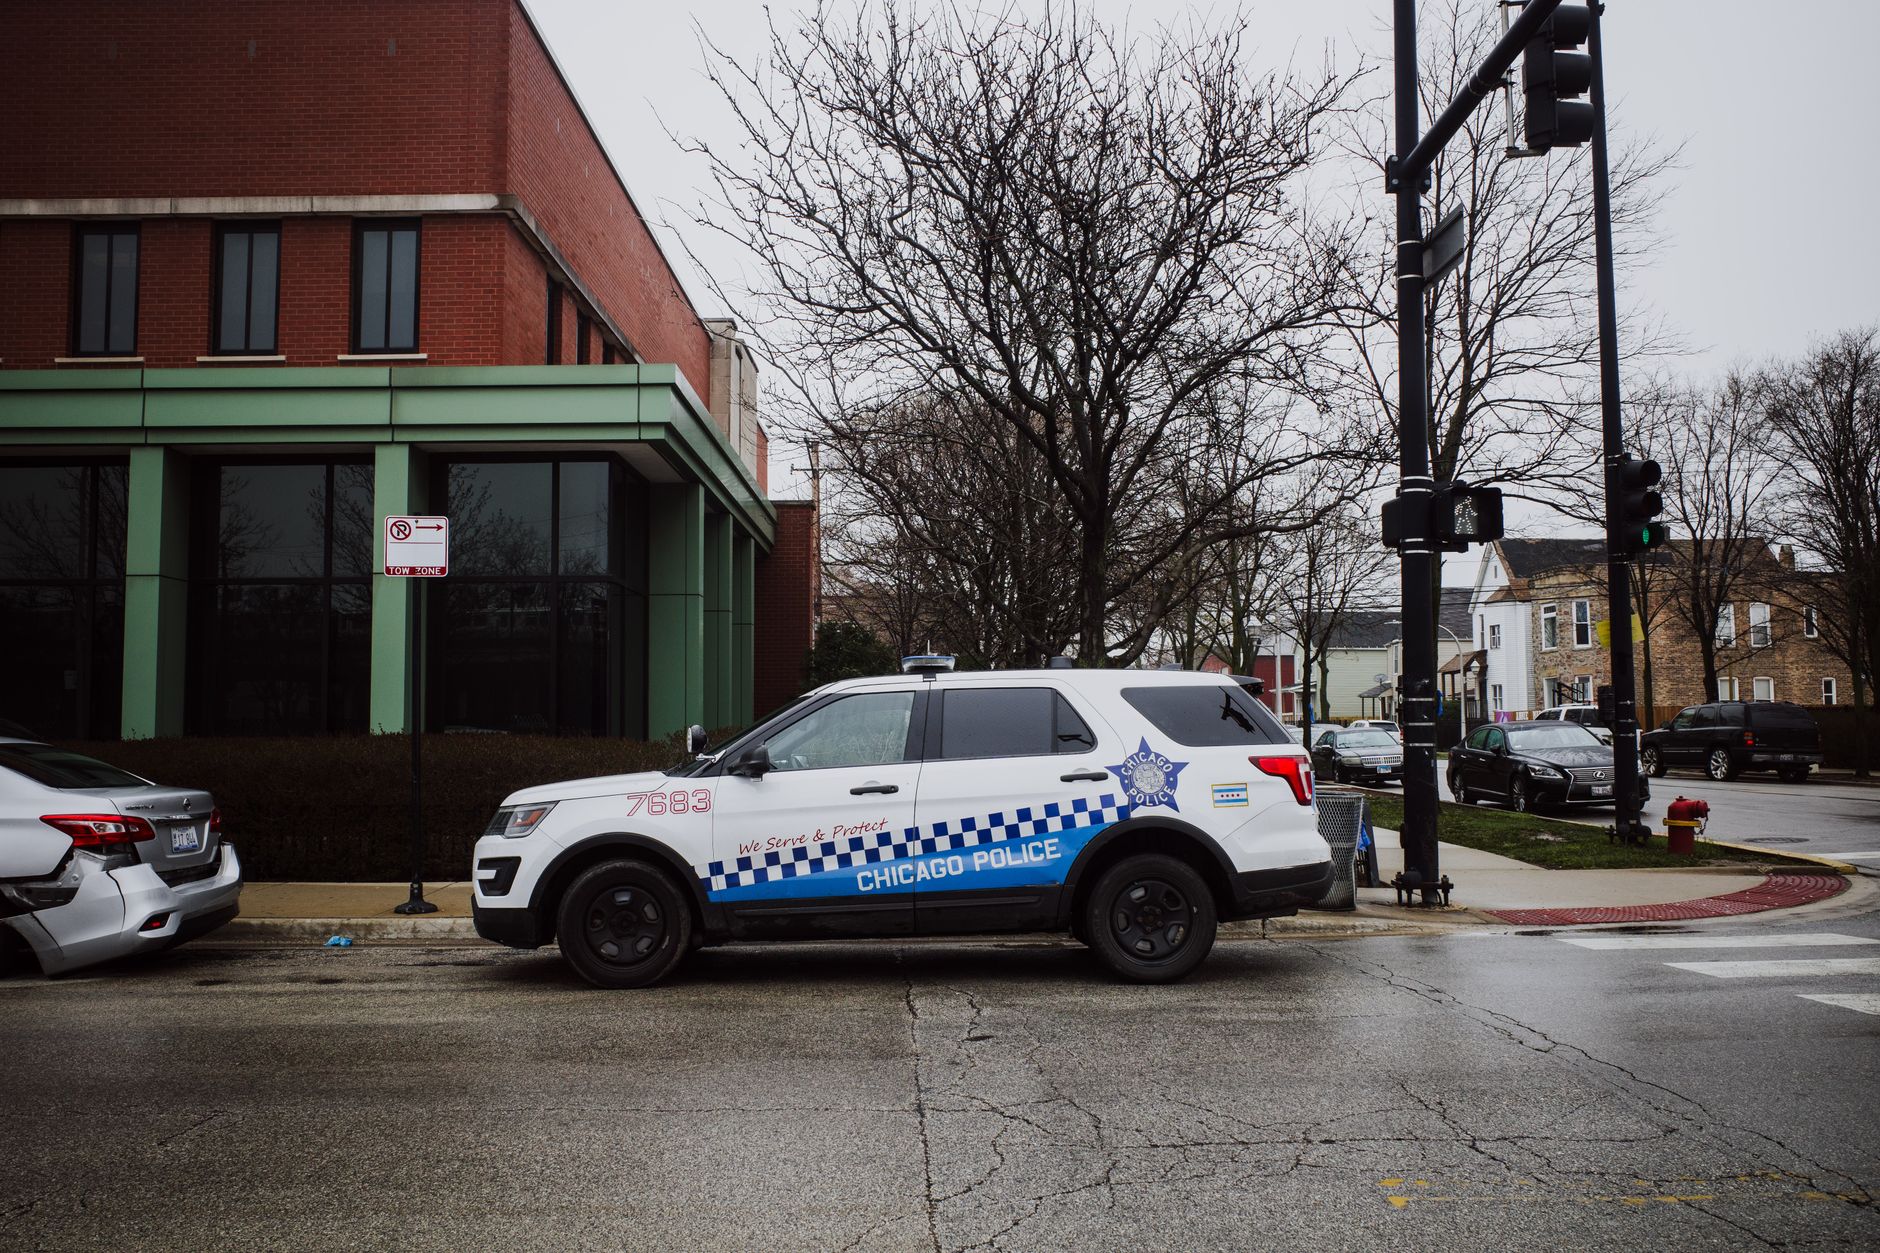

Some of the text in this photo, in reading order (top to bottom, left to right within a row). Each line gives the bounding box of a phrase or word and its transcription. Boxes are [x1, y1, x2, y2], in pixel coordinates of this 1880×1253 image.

[389, 567, 442, 575] TOW ZONE
[1121, 752, 1173, 776] CHICAGO
[626, 788, 712, 817] 7683
[1126, 785, 1175, 806] POLICE
[739, 817, 889, 855] We Serve & Protect
[856, 837, 1063, 892] CHICAGO POLICE
